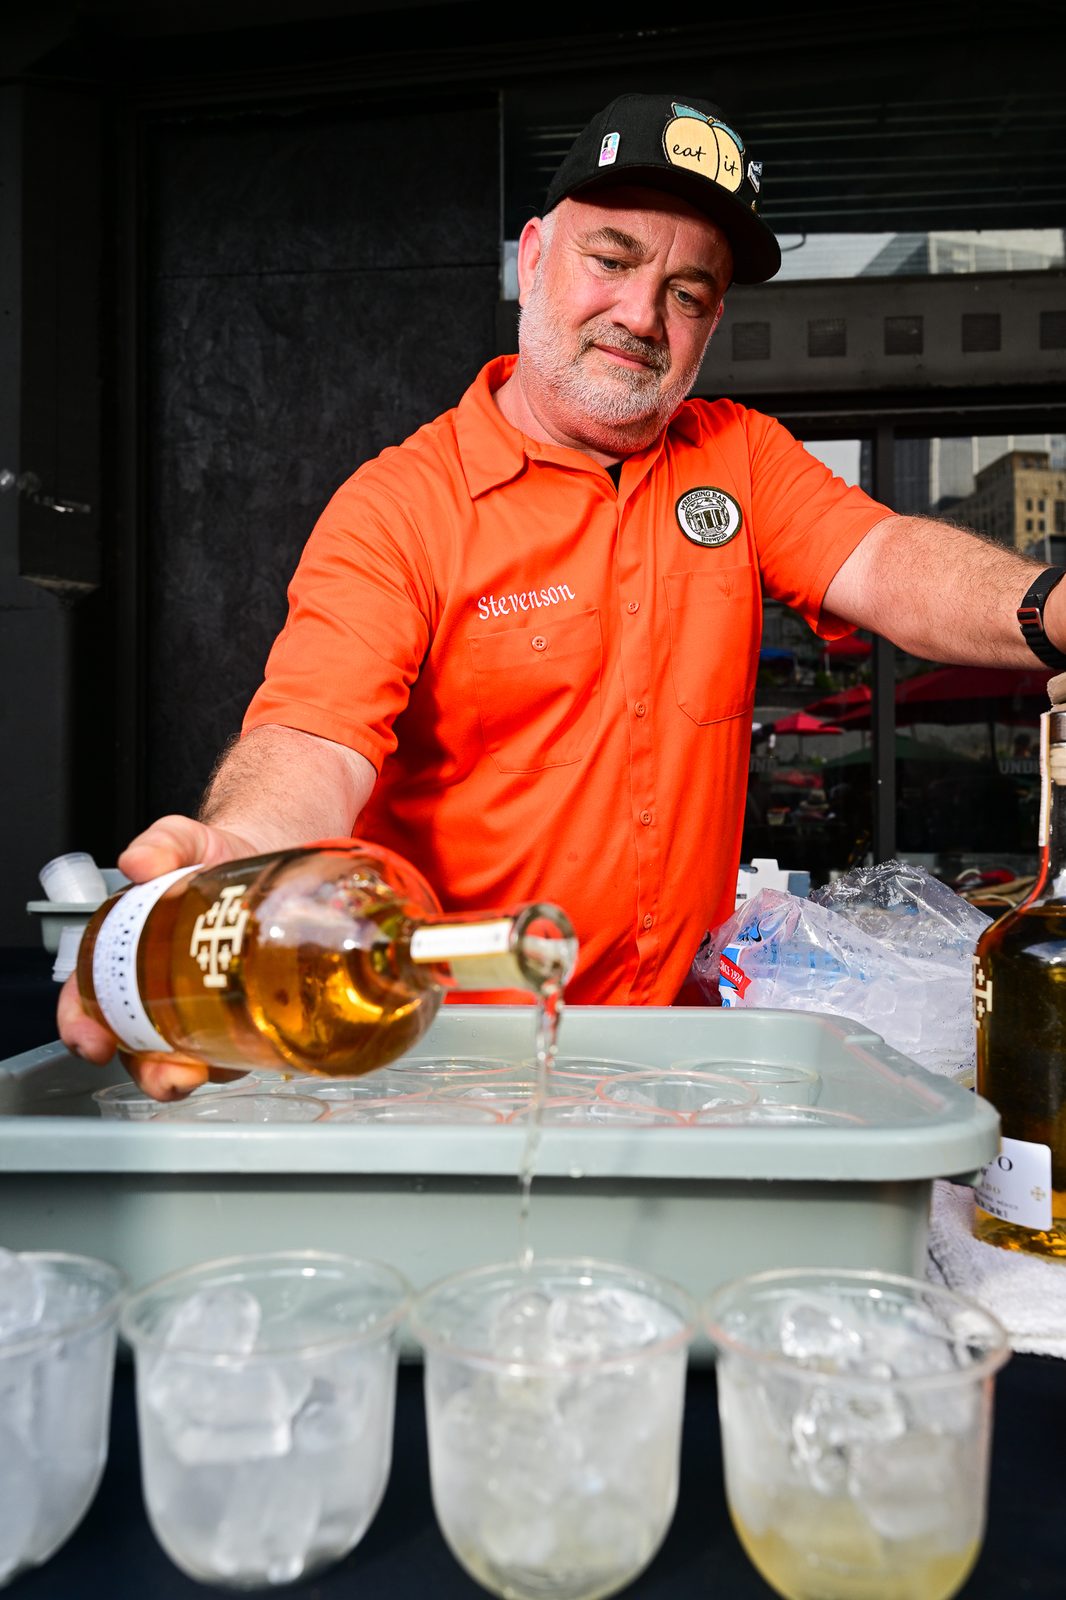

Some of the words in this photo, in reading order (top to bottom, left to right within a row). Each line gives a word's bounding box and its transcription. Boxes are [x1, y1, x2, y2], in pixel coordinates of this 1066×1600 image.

[672, 144, 707, 162] eat
[724, 155, 738, 176] it
[680, 491, 710, 510] WRECKING
[712, 491, 727, 504] BAR
[477, 584, 576, 620] Stevenson
